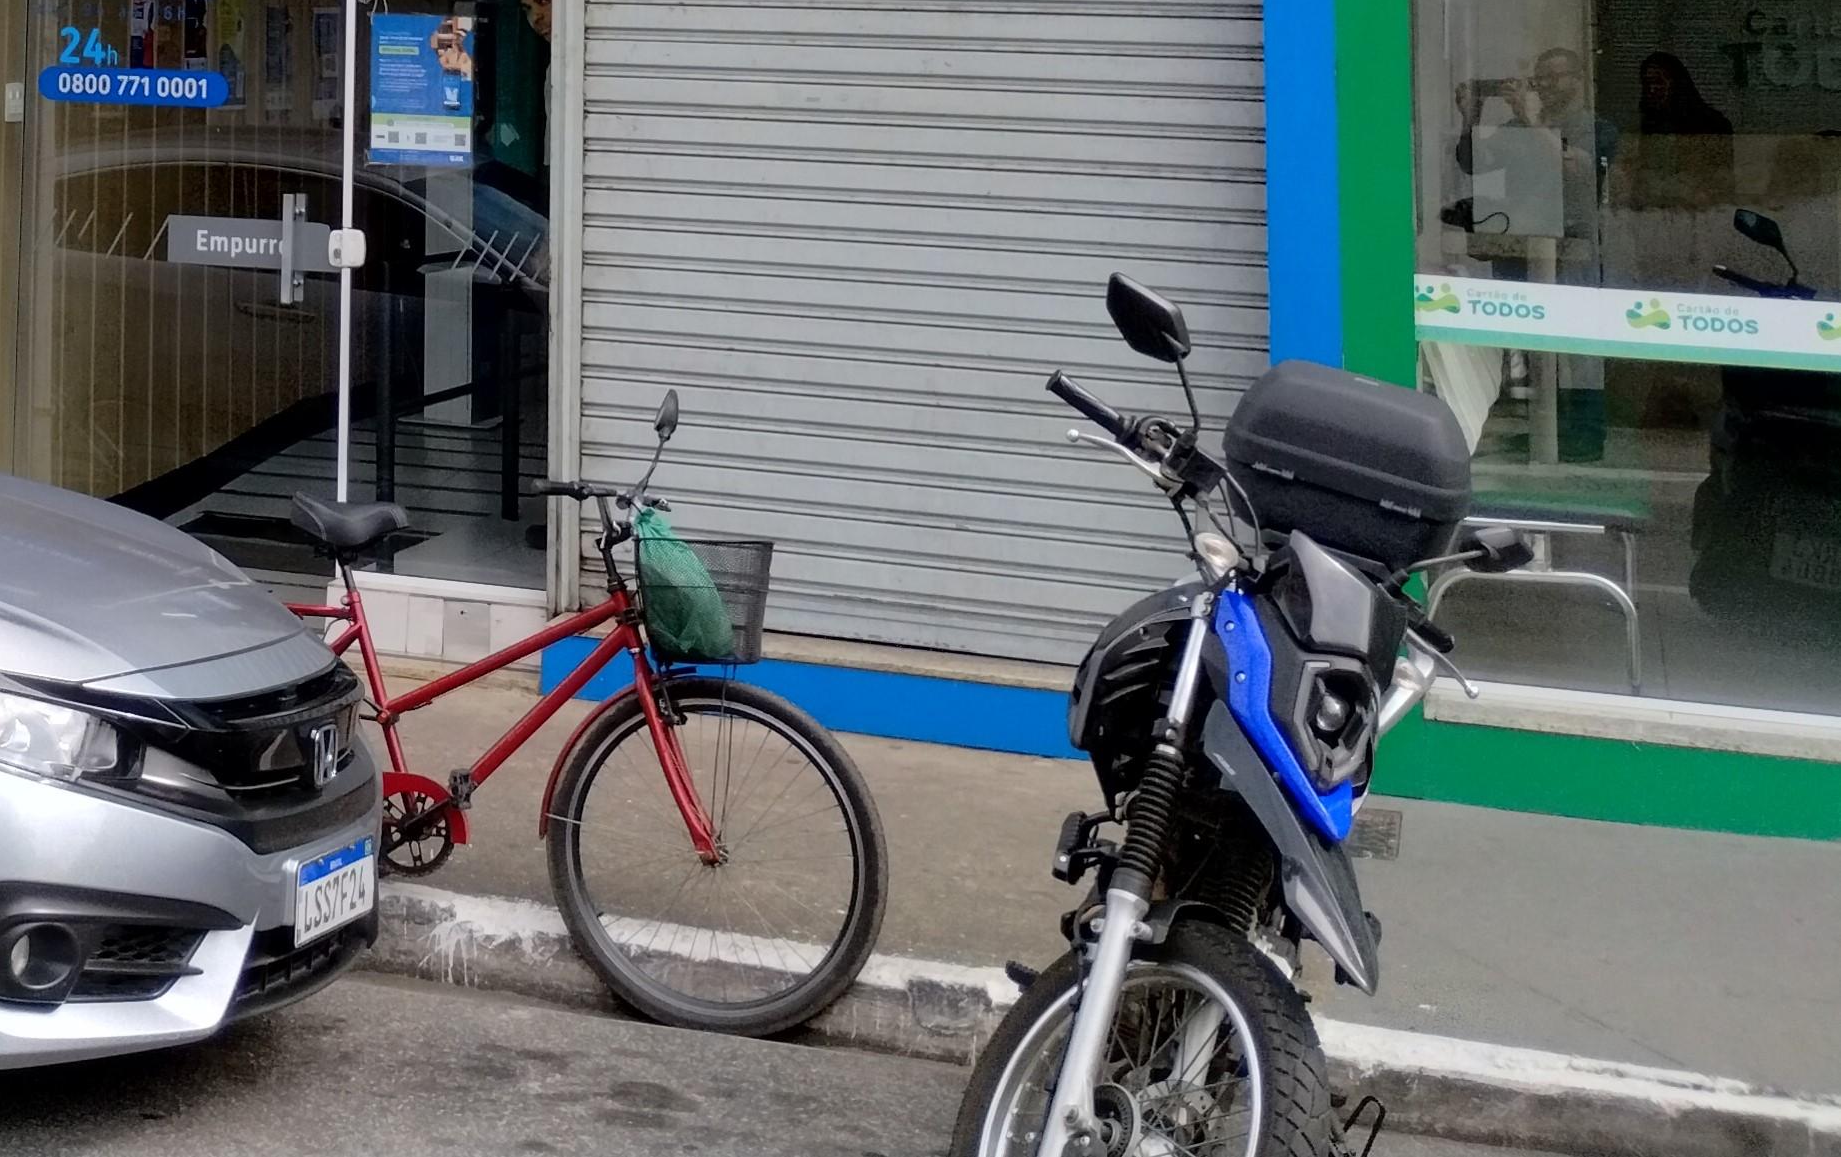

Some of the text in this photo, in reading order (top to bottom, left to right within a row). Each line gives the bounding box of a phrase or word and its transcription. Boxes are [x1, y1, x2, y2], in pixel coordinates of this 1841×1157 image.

[59, 26, 118, 65] 24h
[59, 72, 208, 99] 0800 771 0001
[1467, 300, 1545, 320] TODOS
[1677, 303, 1739, 316] Cartão de
[1678, 315, 1759, 335] TODOS
[304, 865, 366, 934] LSS7F24
